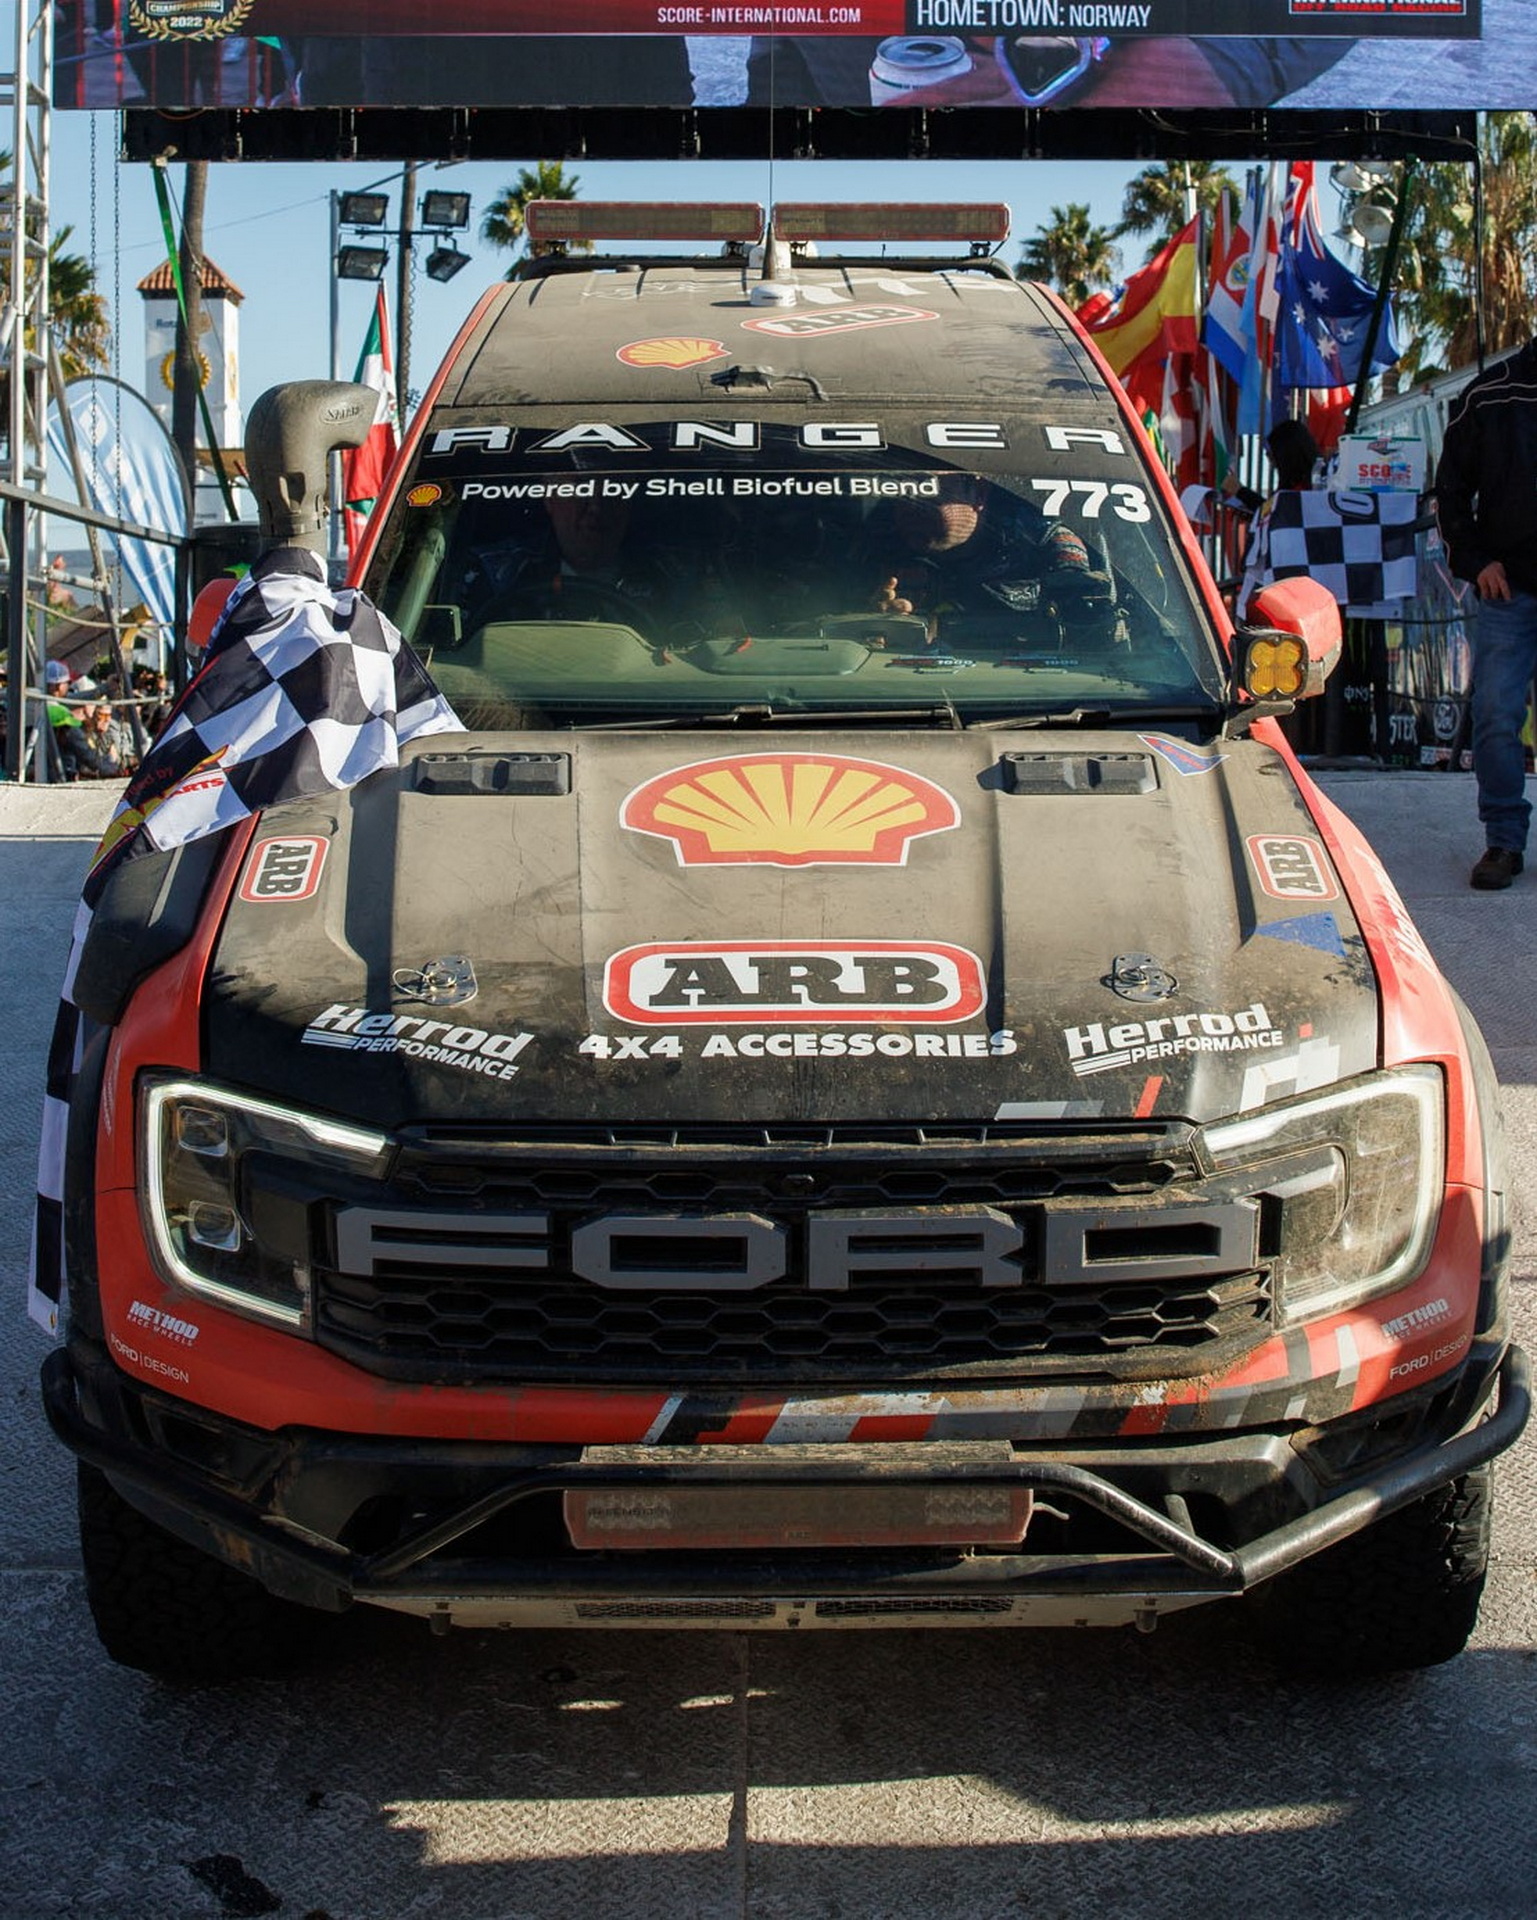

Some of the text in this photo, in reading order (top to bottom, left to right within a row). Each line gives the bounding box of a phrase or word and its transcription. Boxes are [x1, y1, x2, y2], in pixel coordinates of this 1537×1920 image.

[169, 16, 203, 28] 2022
[657, 7, 861, 23] SCORE-INTERNATIONAL.COM
[917, 0, 1152, 27] HOMETOWN: NORWAY
[430, 421, 1126, 455] RANGER
[1358, 463, 1412, 478] SCOE
[461, 477, 940, 501] Powered by Shell Biofuel Blend
[1031, 478, 1152, 523] 773
[256, 844, 313, 896] ARB
[1263, 841, 1324, 893] ARB
[648, 956, 948, 1006] ARB
[309, 1003, 535, 1062] Herrod
[700, 1029, 1018, 1059] ACCESSORIES
[1063, 1002, 1272, 1059] Herrod
[1131, 1030, 1284, 1064] PERFORMANCE
[353, 1036, 520, 1081] PERFORMANCE
[336, 1200, 1260, 1290] FORD
[126, 1313, 150, 1329] RACE
[129, 1300, 200, 1340] METHOD
[1381, 1298, 1449, 1338] METHOD
[143, 1355, 190, 1384] DESIGN
[1389, 1354, 1430, 1380] FORD
